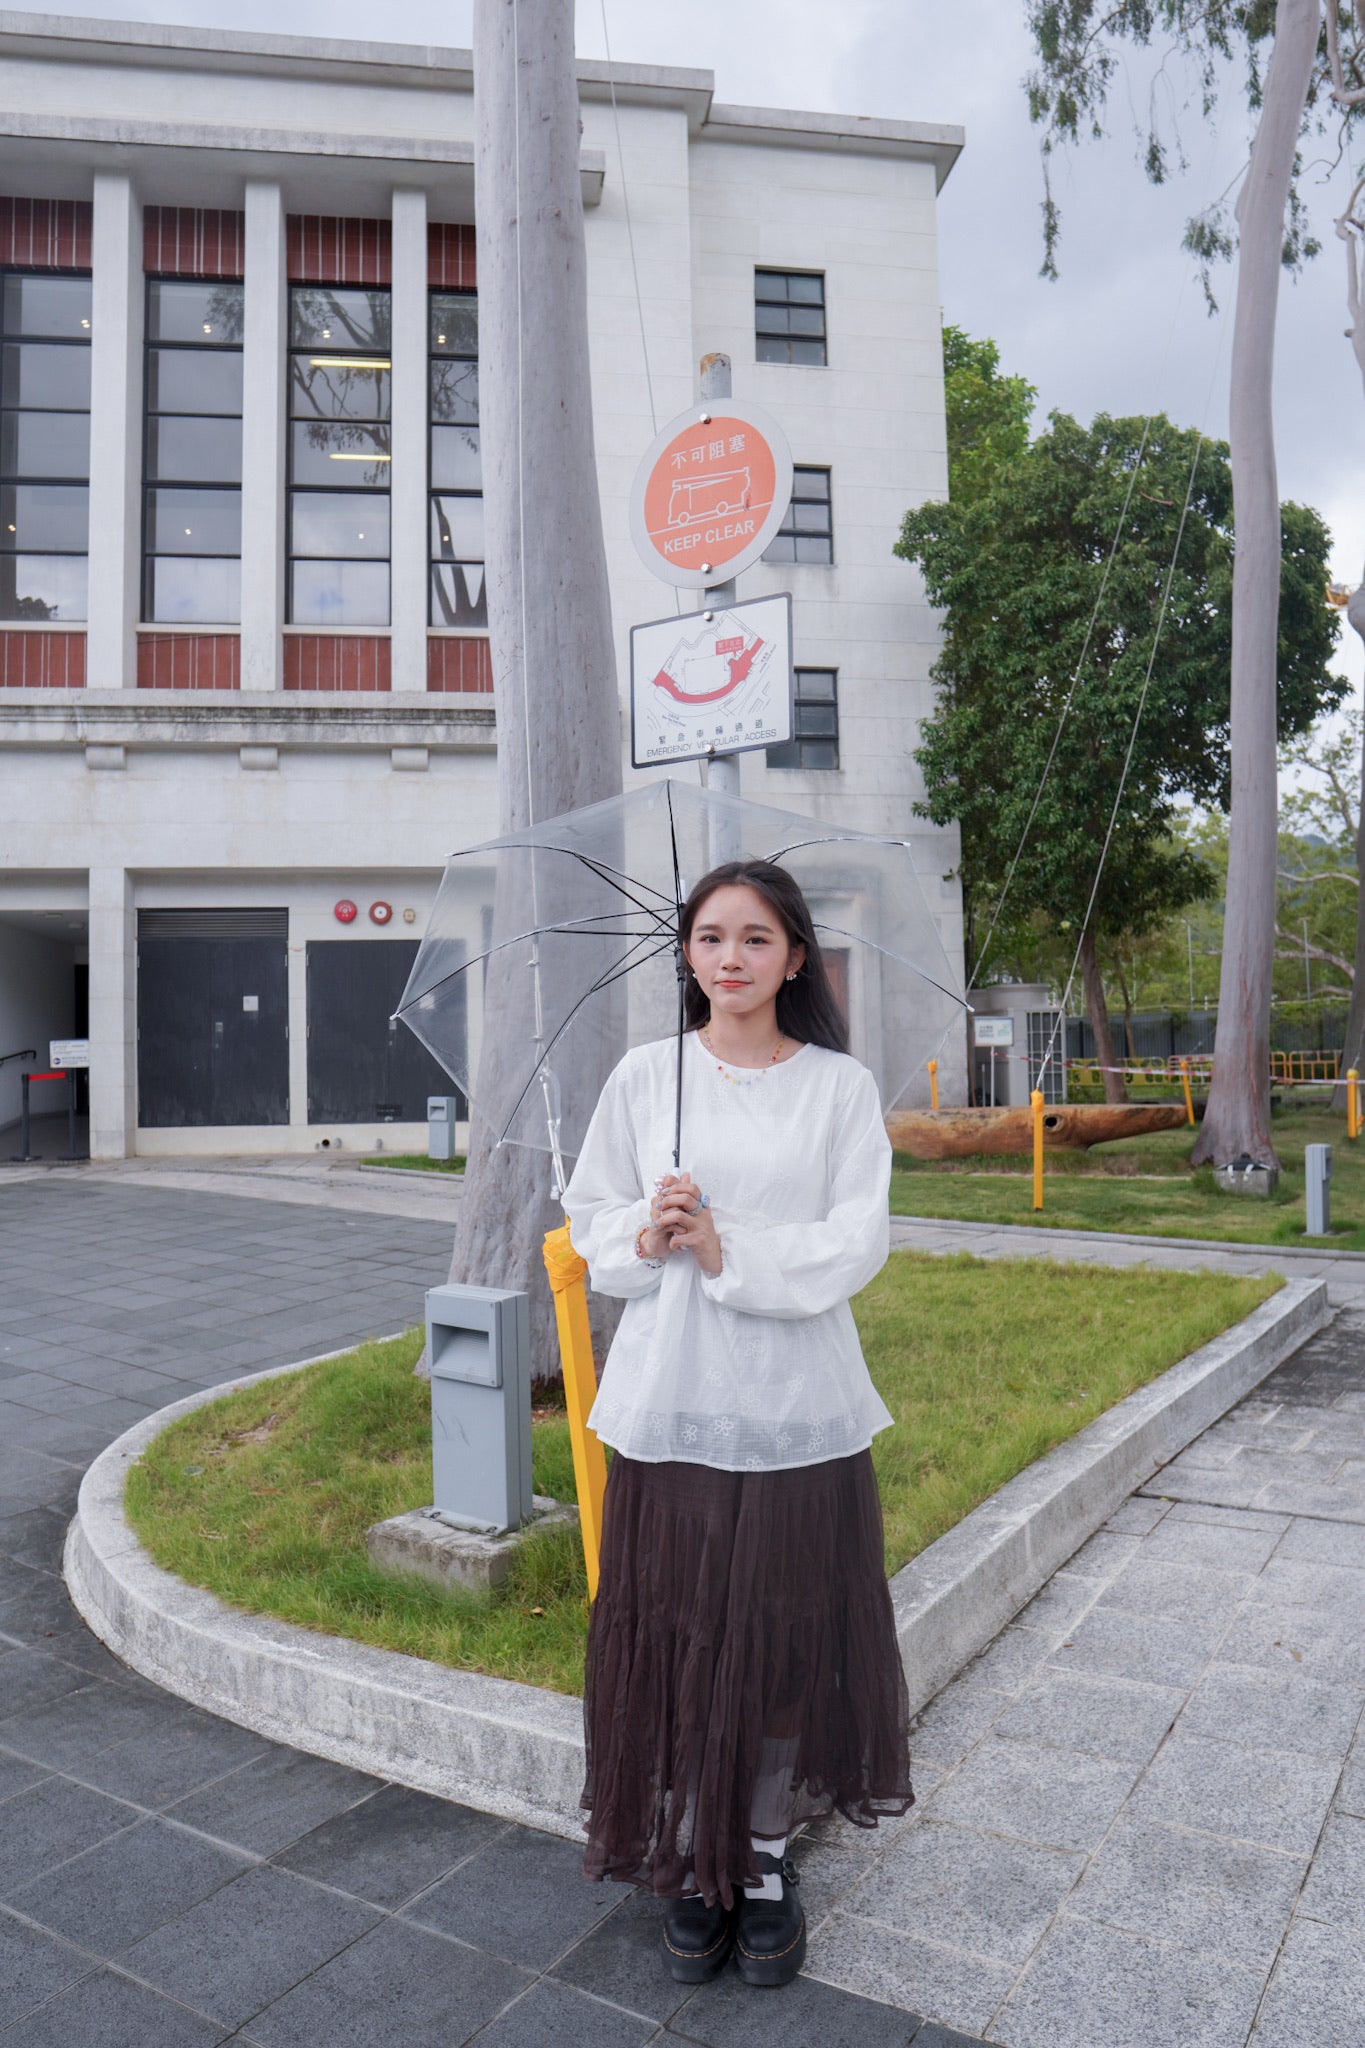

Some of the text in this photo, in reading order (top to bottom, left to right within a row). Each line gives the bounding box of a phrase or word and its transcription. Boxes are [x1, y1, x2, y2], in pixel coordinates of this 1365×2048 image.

[671, 433, 745, 470] 不可阻塞
[663, 519, 755, 555] KEEP CLEAR
[646, 742, 693, 758] EMERGENCY
[744, 728, 777, 742] ACCESS
